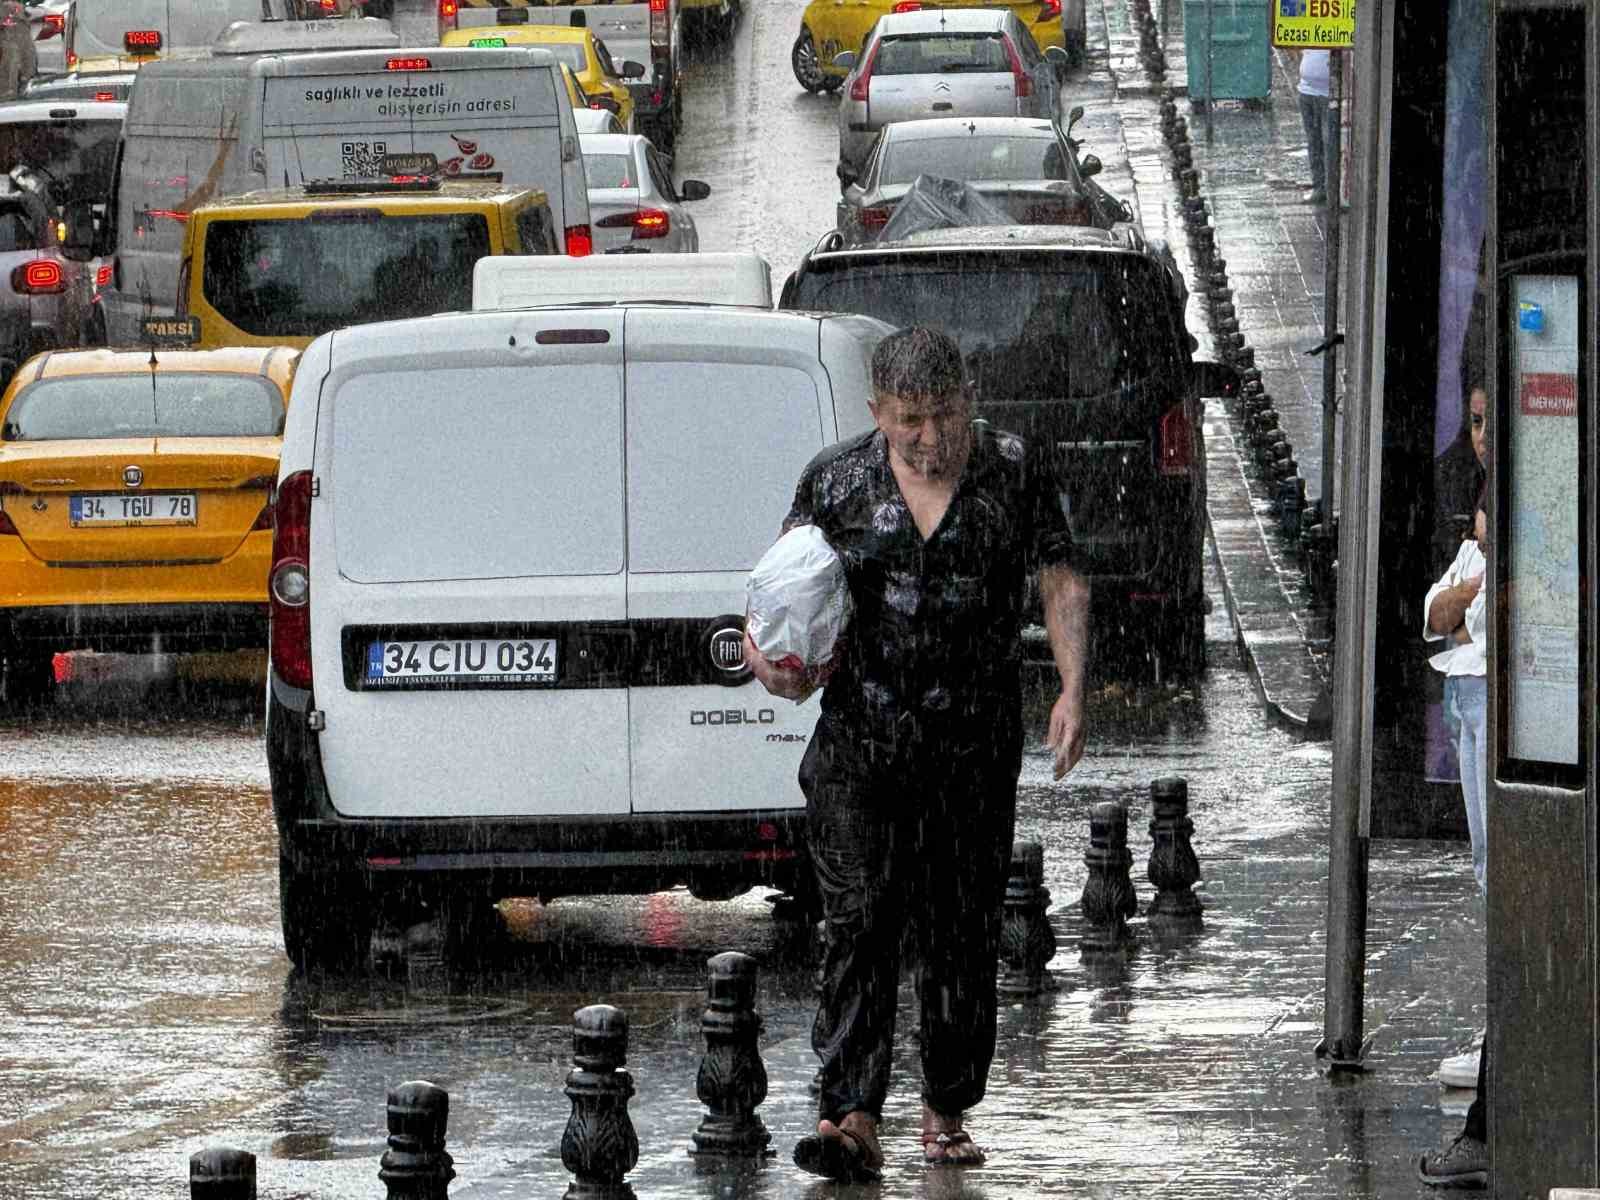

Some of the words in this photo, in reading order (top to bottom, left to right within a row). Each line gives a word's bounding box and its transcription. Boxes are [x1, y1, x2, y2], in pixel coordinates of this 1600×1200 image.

[1310, 0, 1340, 17] EDS
[1276, 24, 1310, 42] Cezası
[305, 86, 361, 103] sağlıklı
[365, 88, 384, 99] ve
[388, 82, 445, 98] lezzetli
[466, 95, 517, 112] adresi
[84, 499, 105, 518] 34
[120, 497, 153, 518] TGU
[385, 642, 421, 674] 34
[428, 641, 487, 673] CIU
[497, 640, 553, 672] 034
[690, 708, 775, 725] DOBLO
[765, 733, 807, 743] max
